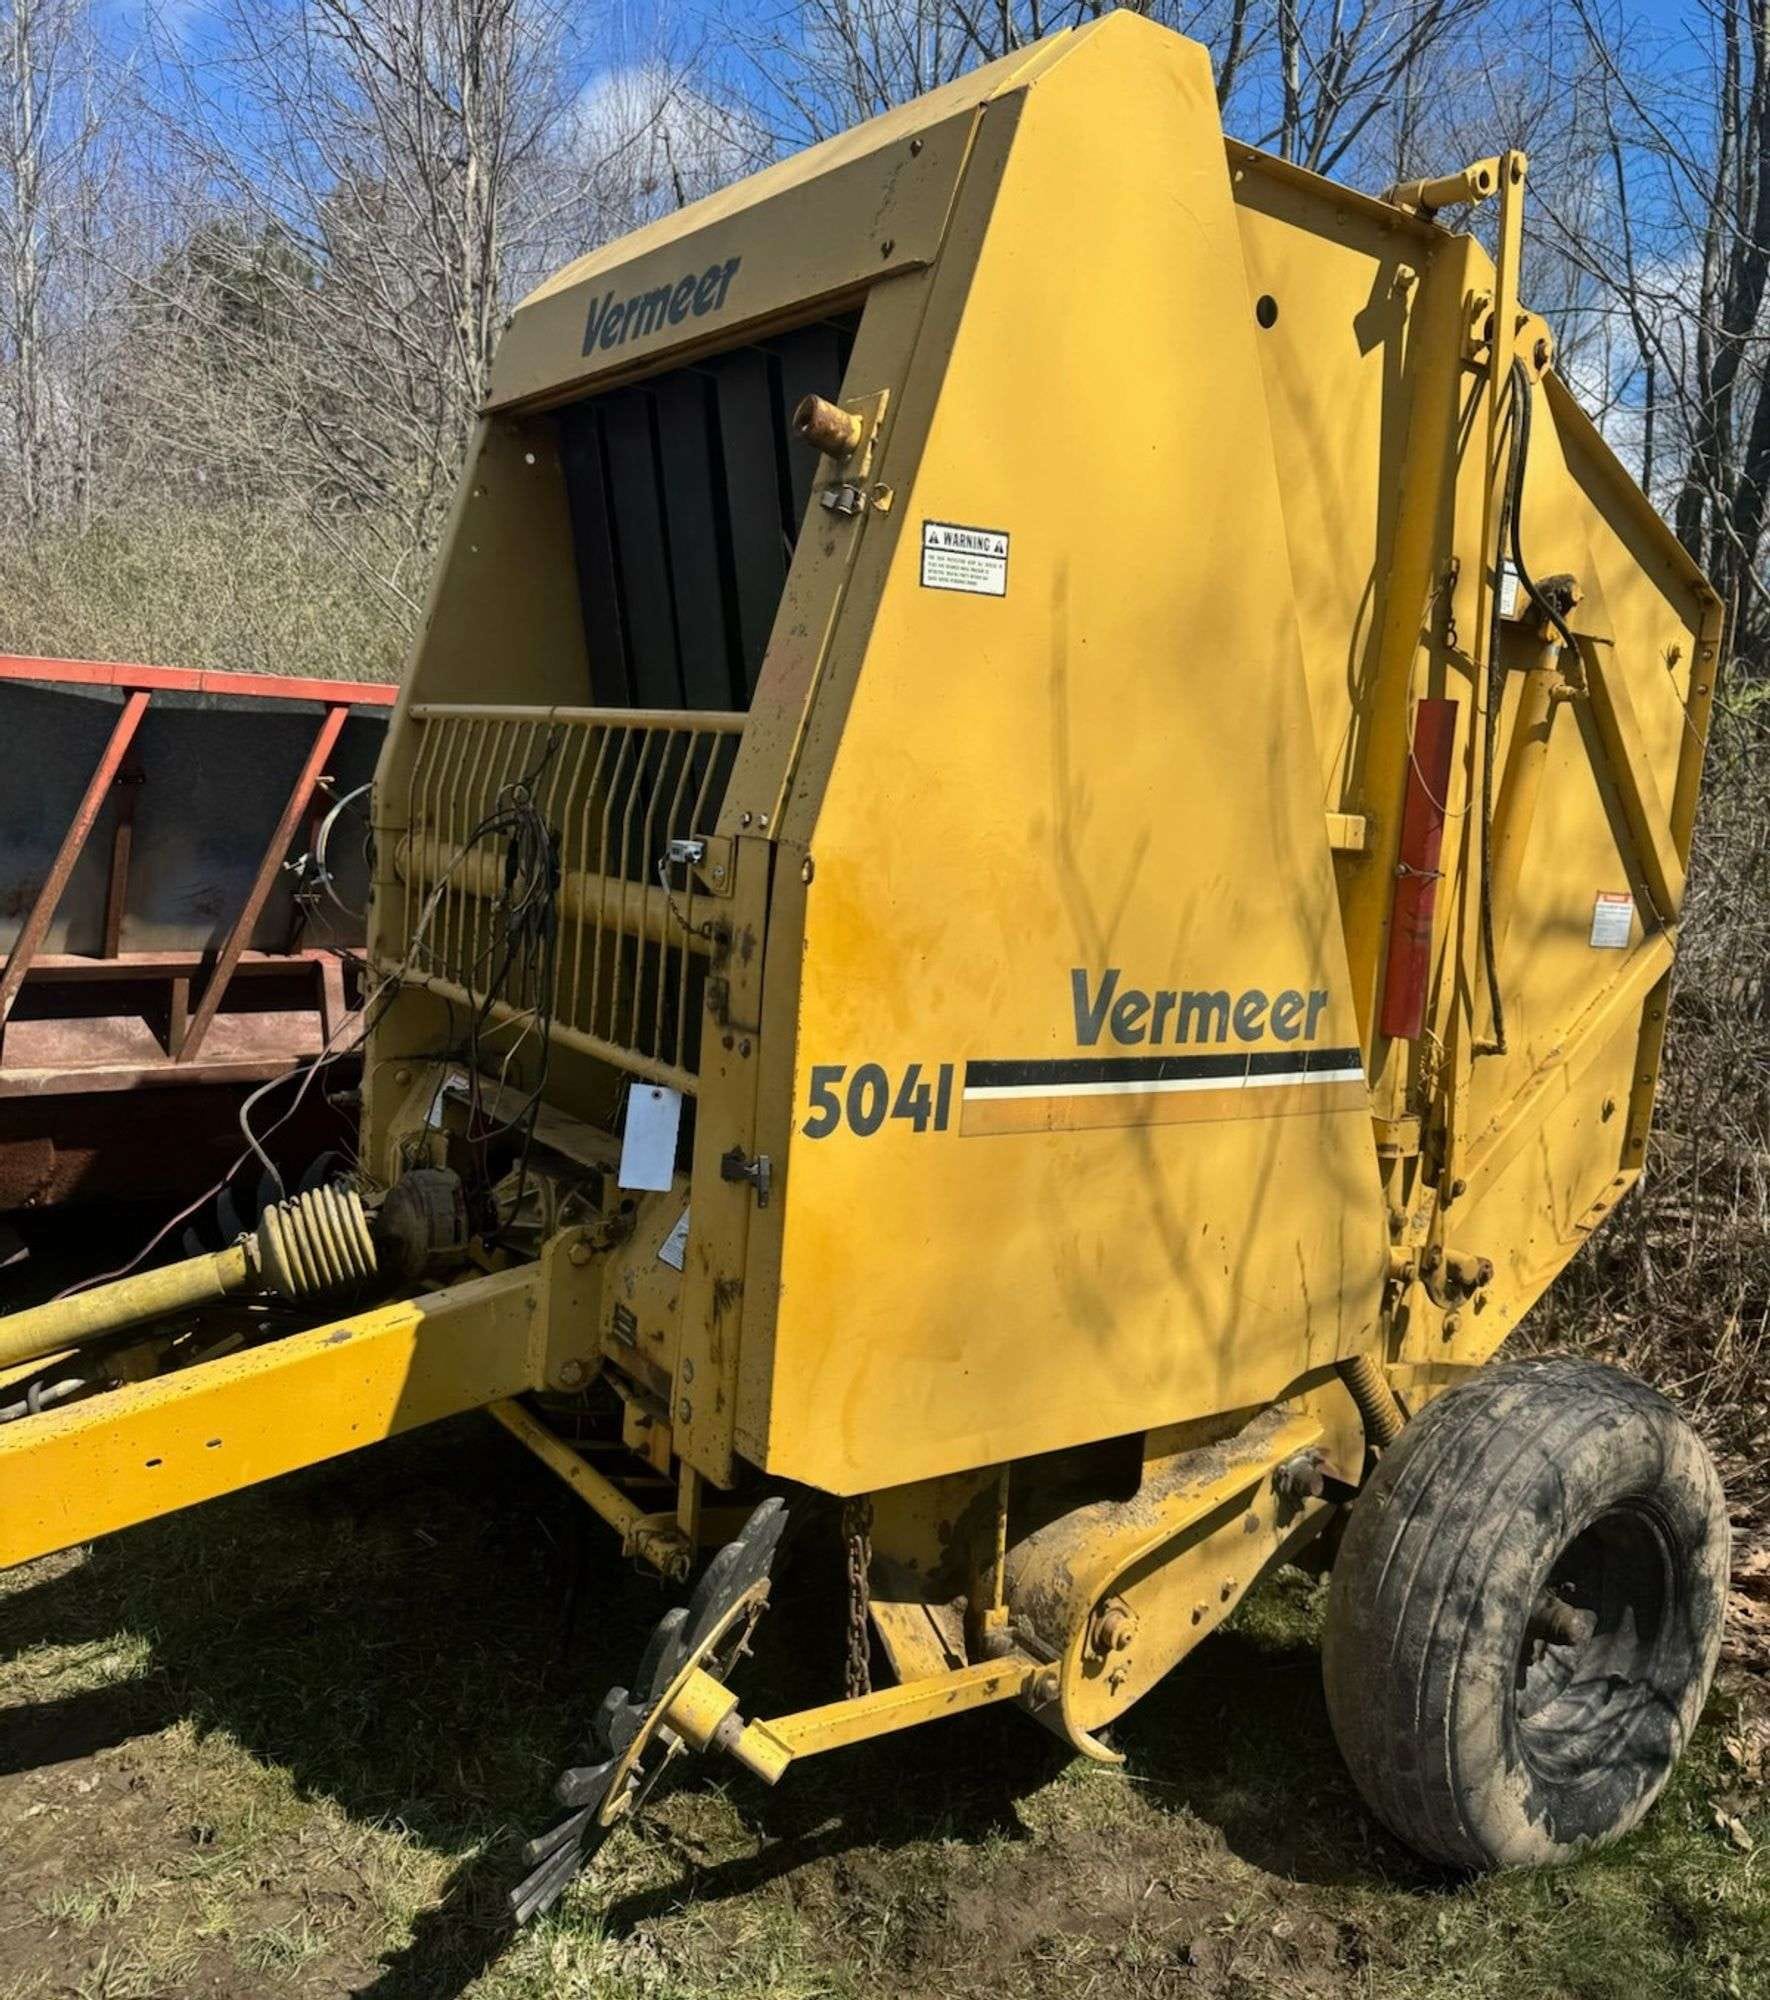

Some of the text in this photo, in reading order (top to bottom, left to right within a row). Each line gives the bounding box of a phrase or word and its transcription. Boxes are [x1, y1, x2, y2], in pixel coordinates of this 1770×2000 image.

[582, 257, 742, 357] Vermeer
[943, 531, 991, 551] WARNING
[1071, 968, 1328, 1046] Vermeer
[802, 1063, 954, 1139] 5041
